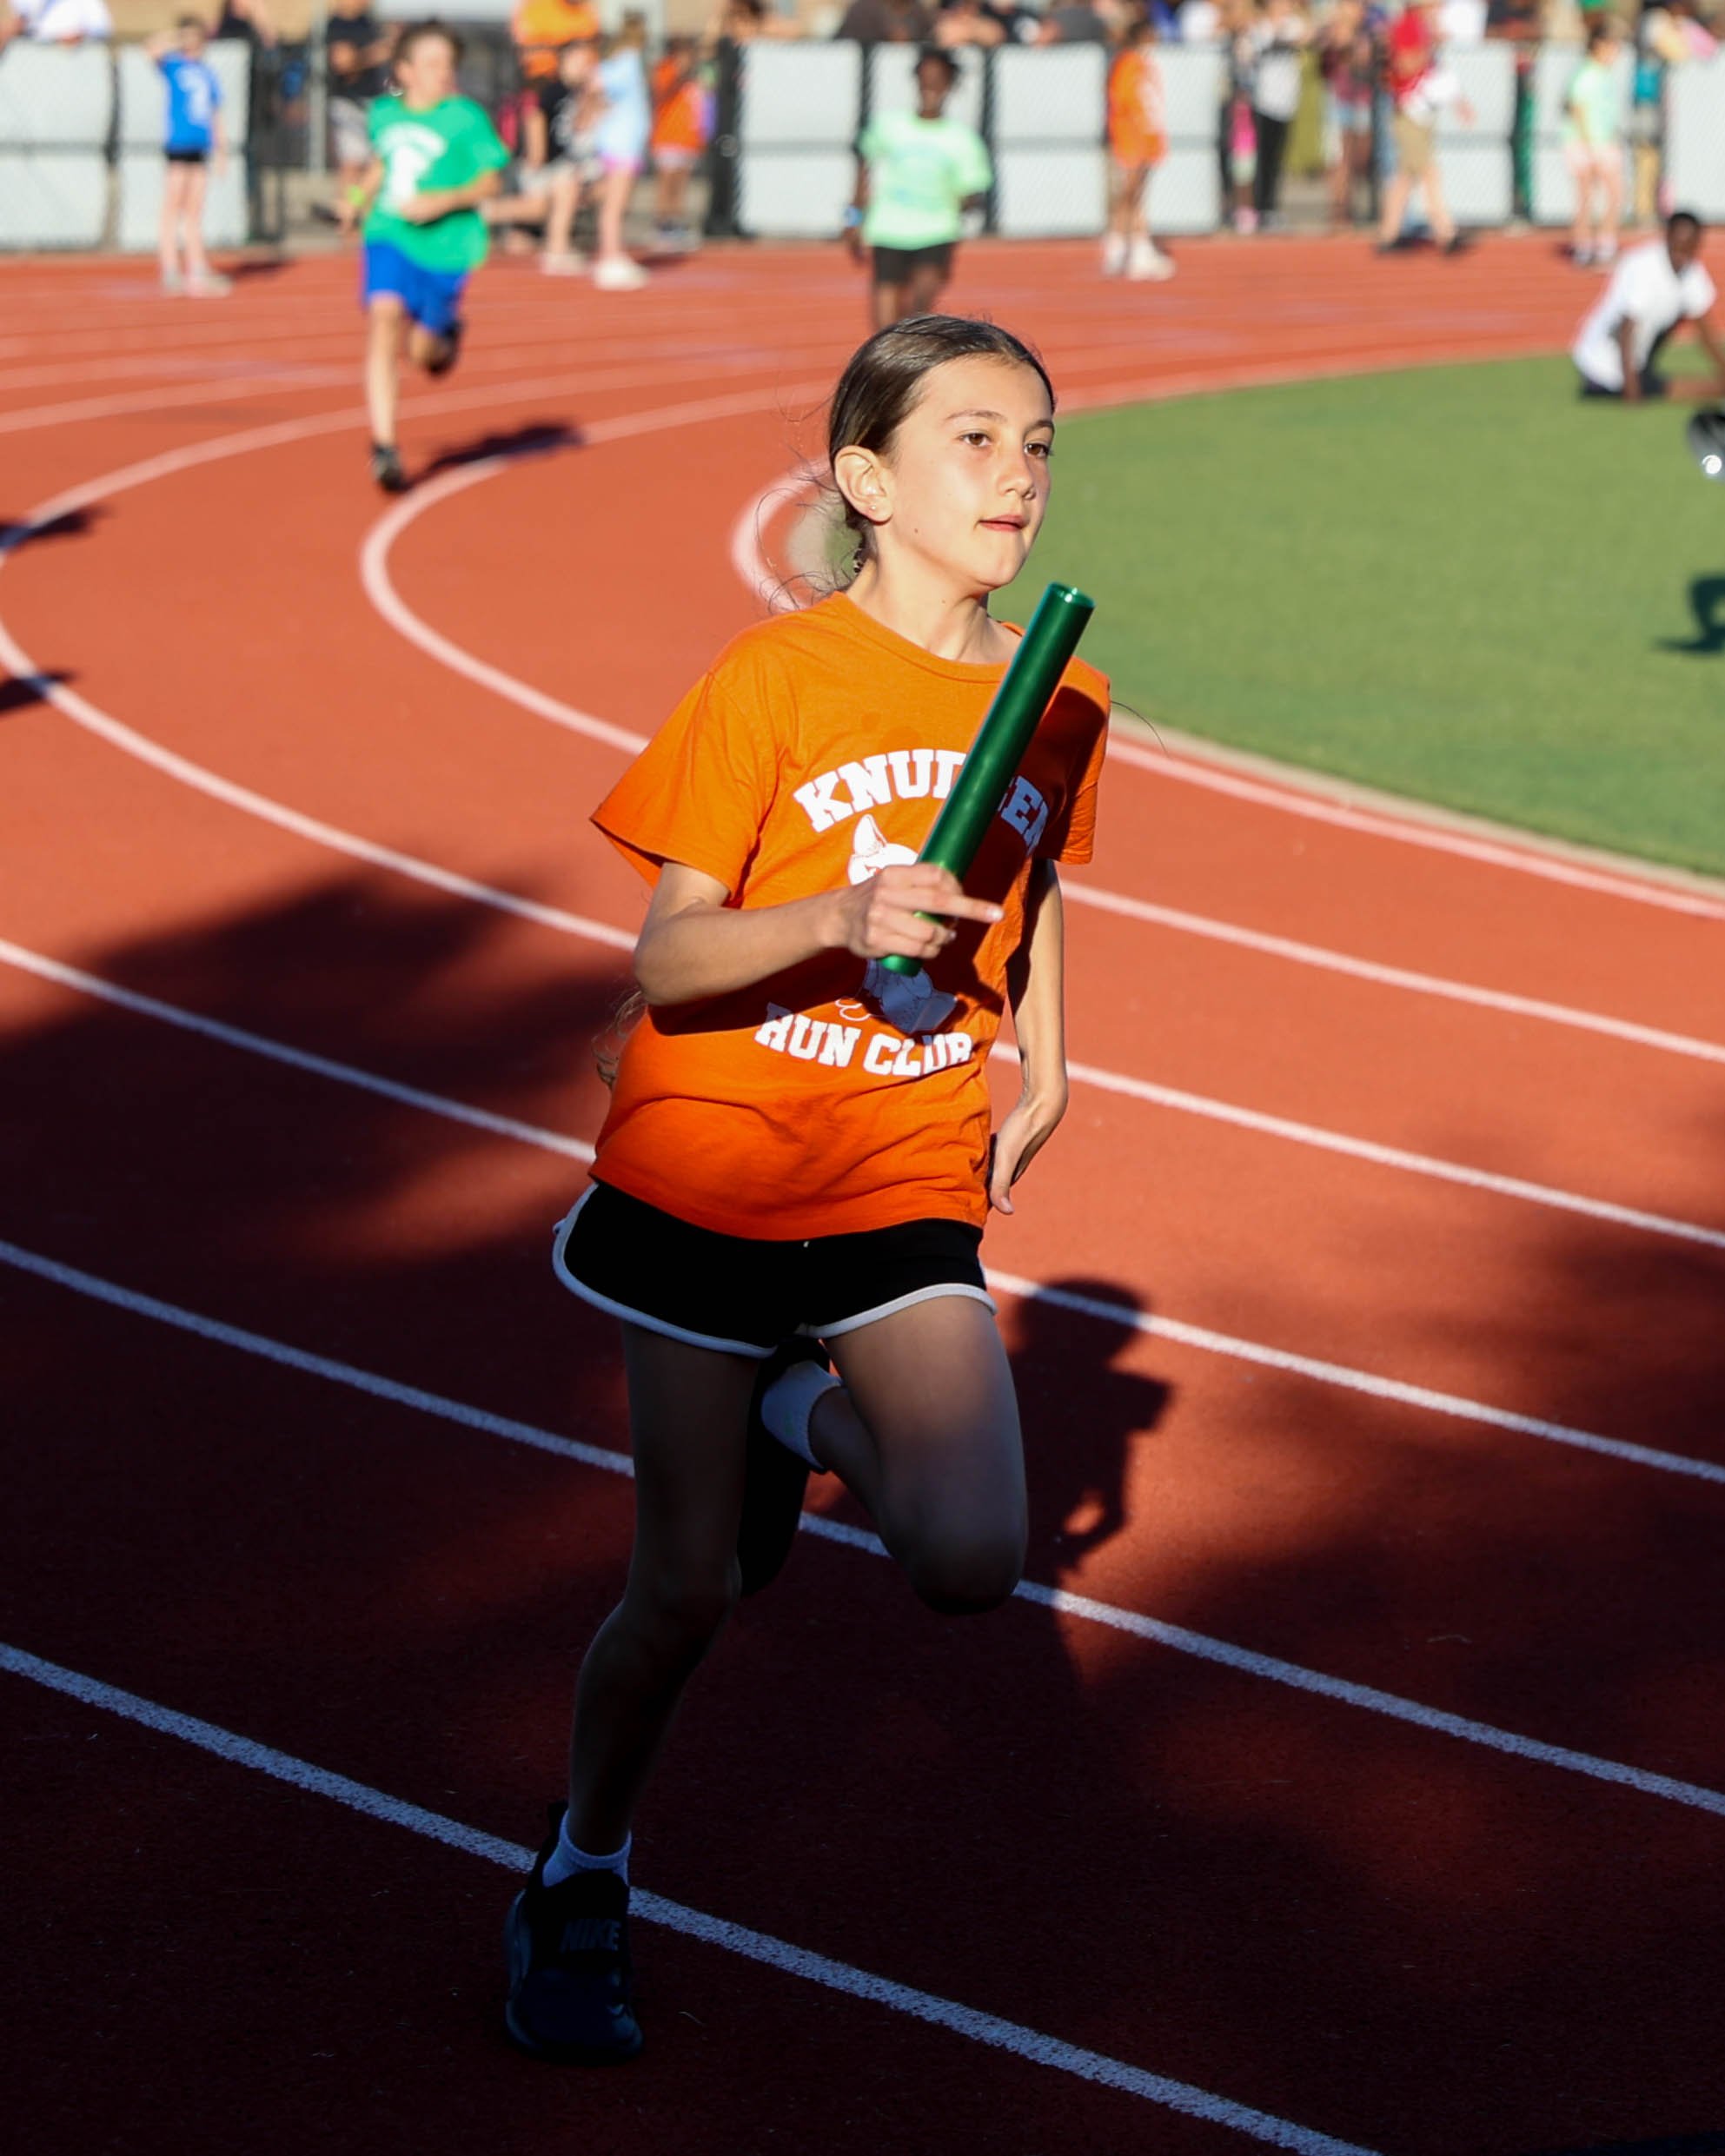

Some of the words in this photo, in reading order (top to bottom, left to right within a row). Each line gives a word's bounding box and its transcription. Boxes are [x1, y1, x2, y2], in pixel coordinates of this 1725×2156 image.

[754, 1002, 862, 1068] RUN
[863, 1032, 972, 1077] CLUB
[560, 1919, 620, 1952] NIKE
